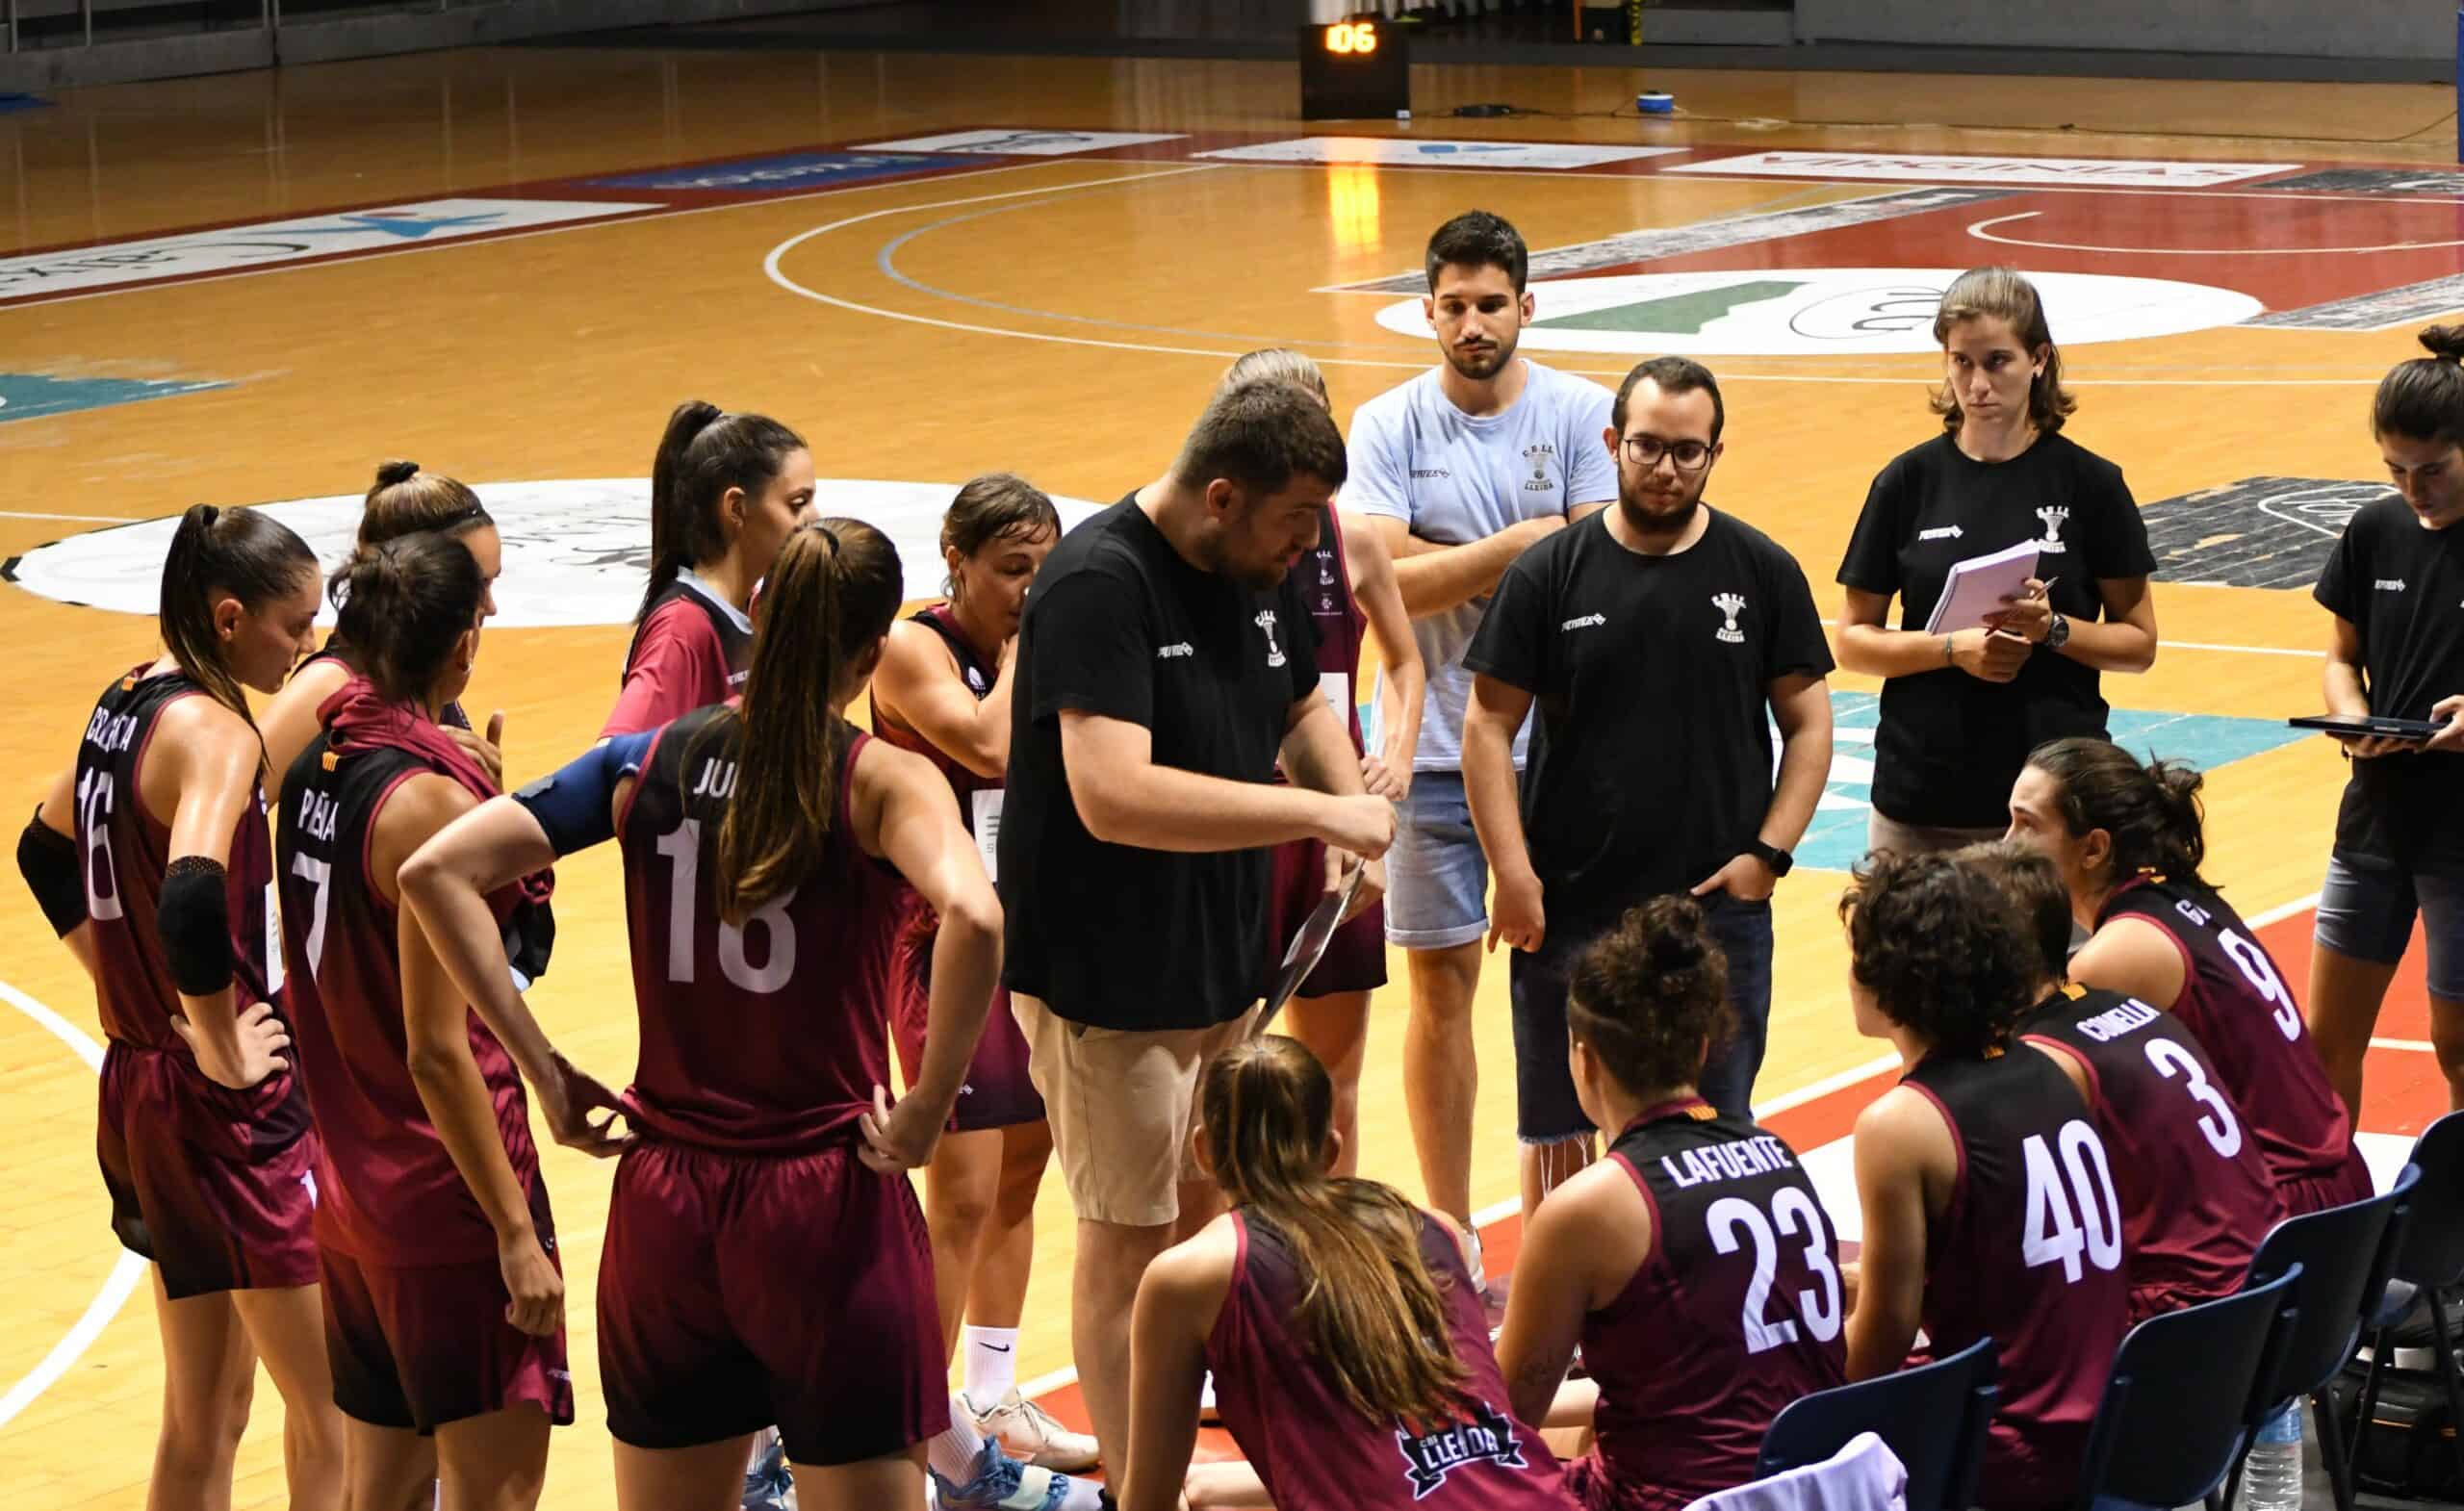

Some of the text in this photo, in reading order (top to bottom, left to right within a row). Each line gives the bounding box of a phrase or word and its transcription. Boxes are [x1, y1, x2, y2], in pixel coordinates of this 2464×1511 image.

[77, 767, 123, 921] 16
[292, 851, 332, 986] 7
[2218, 928, 2301, 1041] 9
[2144, 1038, 2242, 1158] 3
[1661, 1136, 1793, 1189] LAFUENTE
[2022, 1119, 2122, 1284] 40
[1706, 1186, 1841, 1355] 23
[1422, 1423, 1500, 1470] LLEIDA
